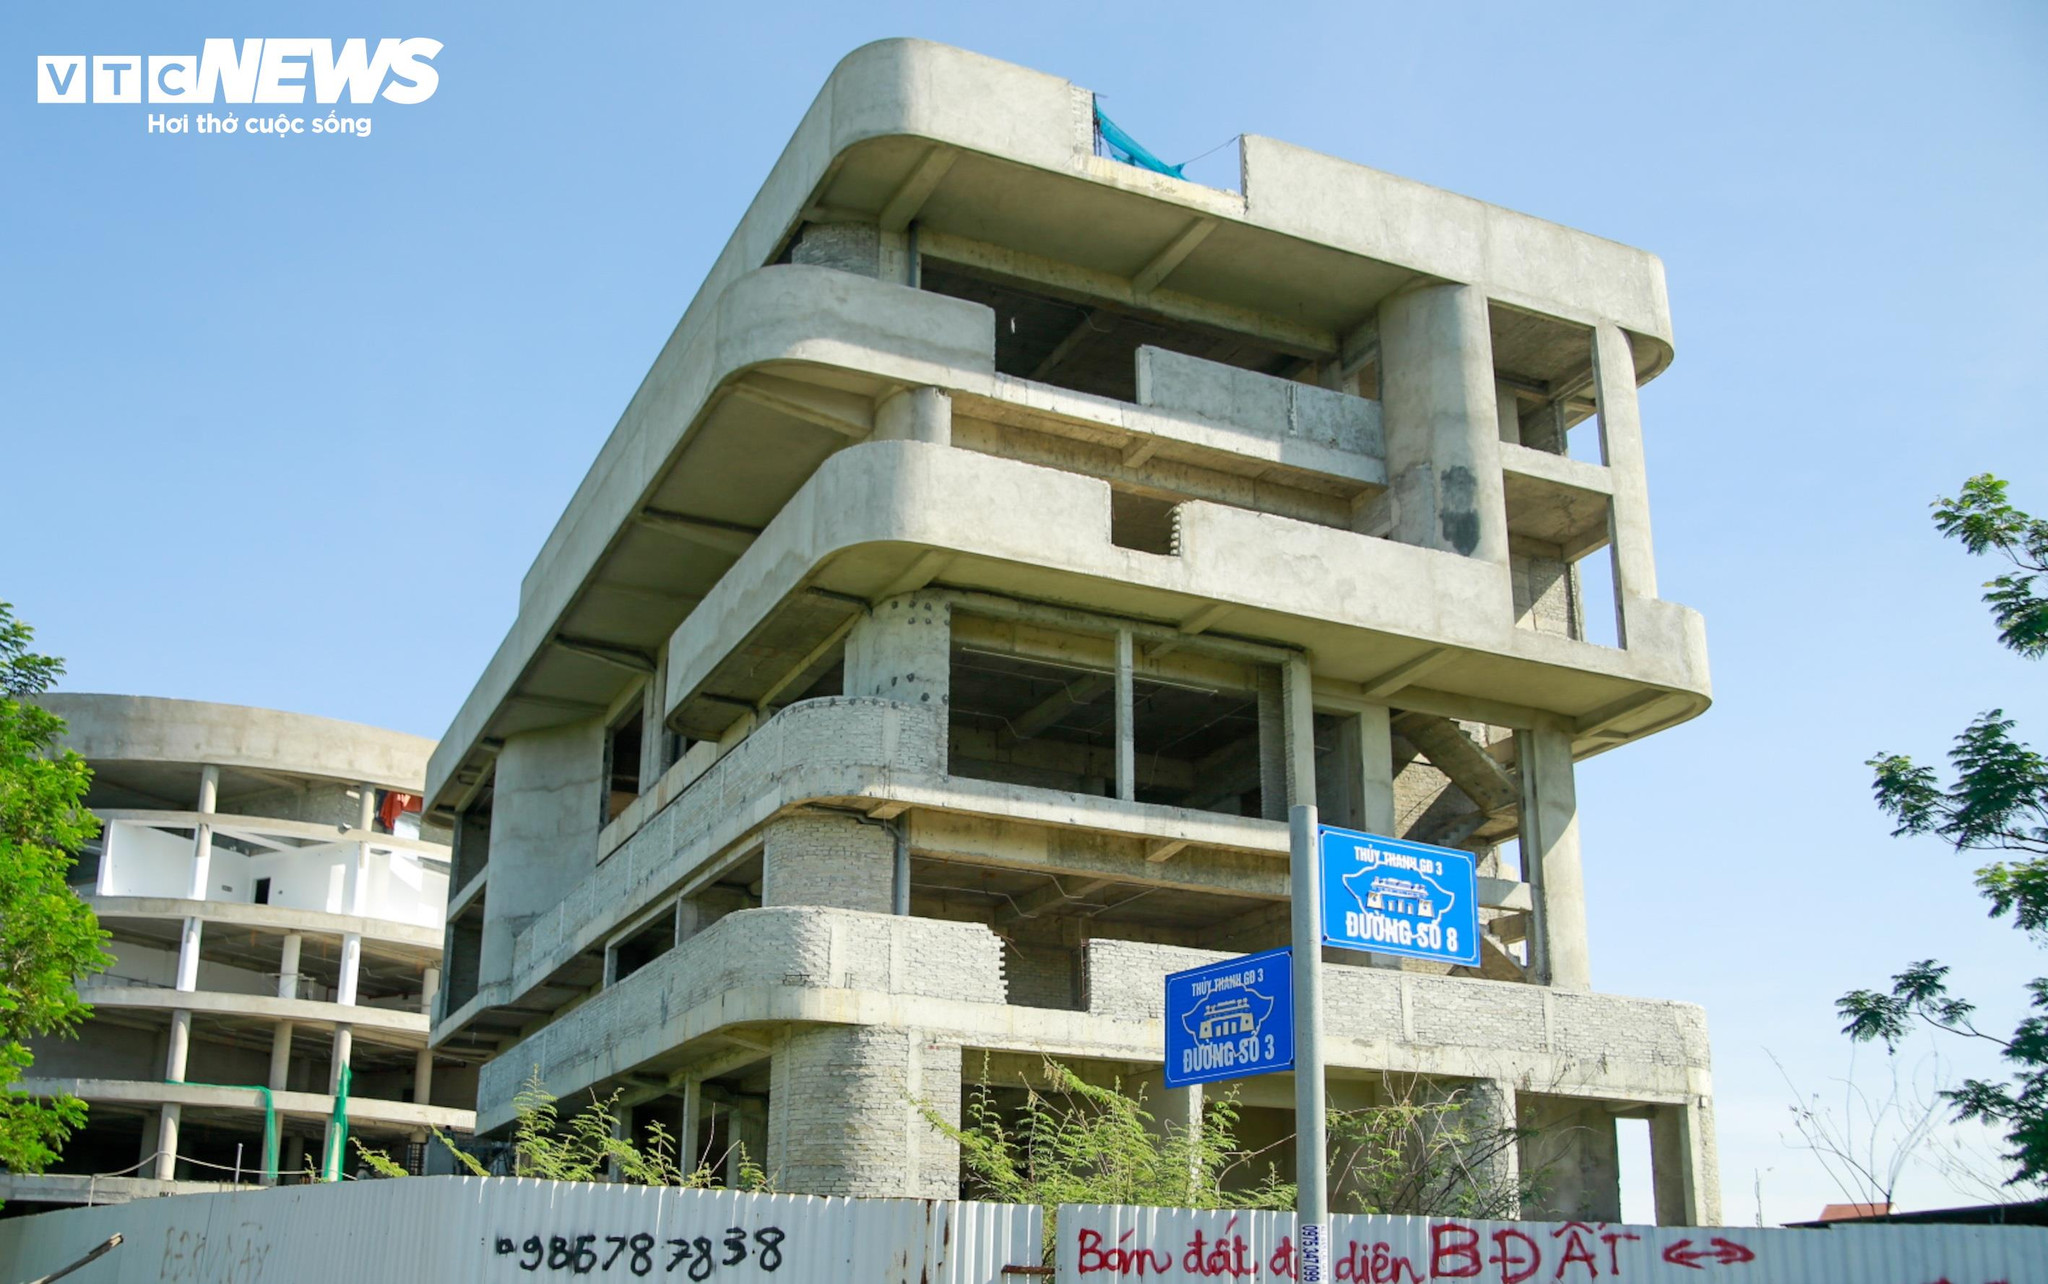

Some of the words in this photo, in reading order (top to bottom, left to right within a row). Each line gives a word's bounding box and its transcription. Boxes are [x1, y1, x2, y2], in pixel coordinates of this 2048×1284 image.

[1382, 851, 1418, 871] THANH
[1435, 861, 1443, 876] 3
[1345, 911, 1412, 946] ĐƯỜNG
[1416, 919, 1442, 950] SỐ
[1446, 927, 1458, 952] 8
[1191, 976, 1212, 997] THỦY
[1213, 972, 1241, 992] THANH
[1257, 967, 1264, 982] 3
[1182, 1039, 1234, 1074] ĐƯỜNG
[1264, 1033, 1275, 1060] 3
[1183, 1216, 1258, 1278] đất
